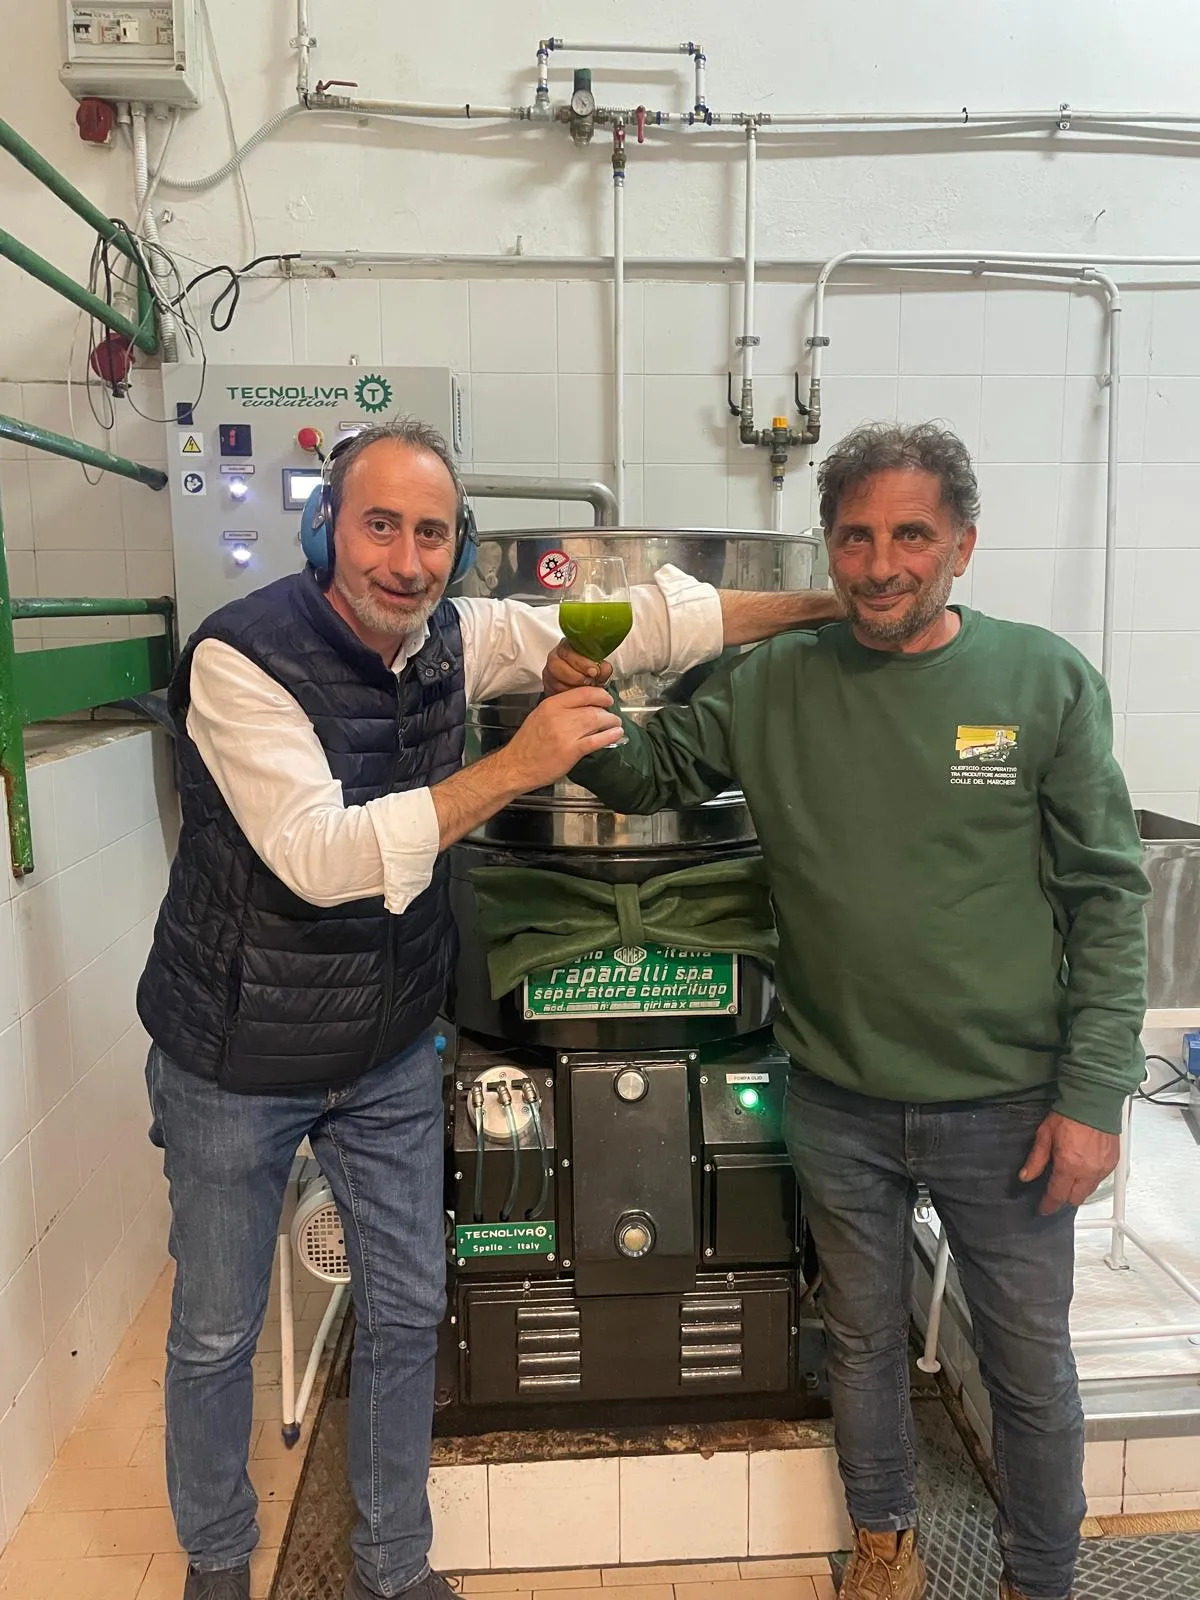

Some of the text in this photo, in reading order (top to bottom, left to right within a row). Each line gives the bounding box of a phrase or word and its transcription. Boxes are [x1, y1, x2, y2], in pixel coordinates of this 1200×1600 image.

[226, 386, 349, 400] TECNOLIVA
[242, 395, 339, 408] evolution
[550, 964, 669, 987] rapanelli
[534, 982, 727, 1001] separatore centrifugo
[465, 1228, 534, 1240] TECNOLIVA
[473, 1243, 503, 1253] Spello
[517, 1242, 540, 1251] Italy
